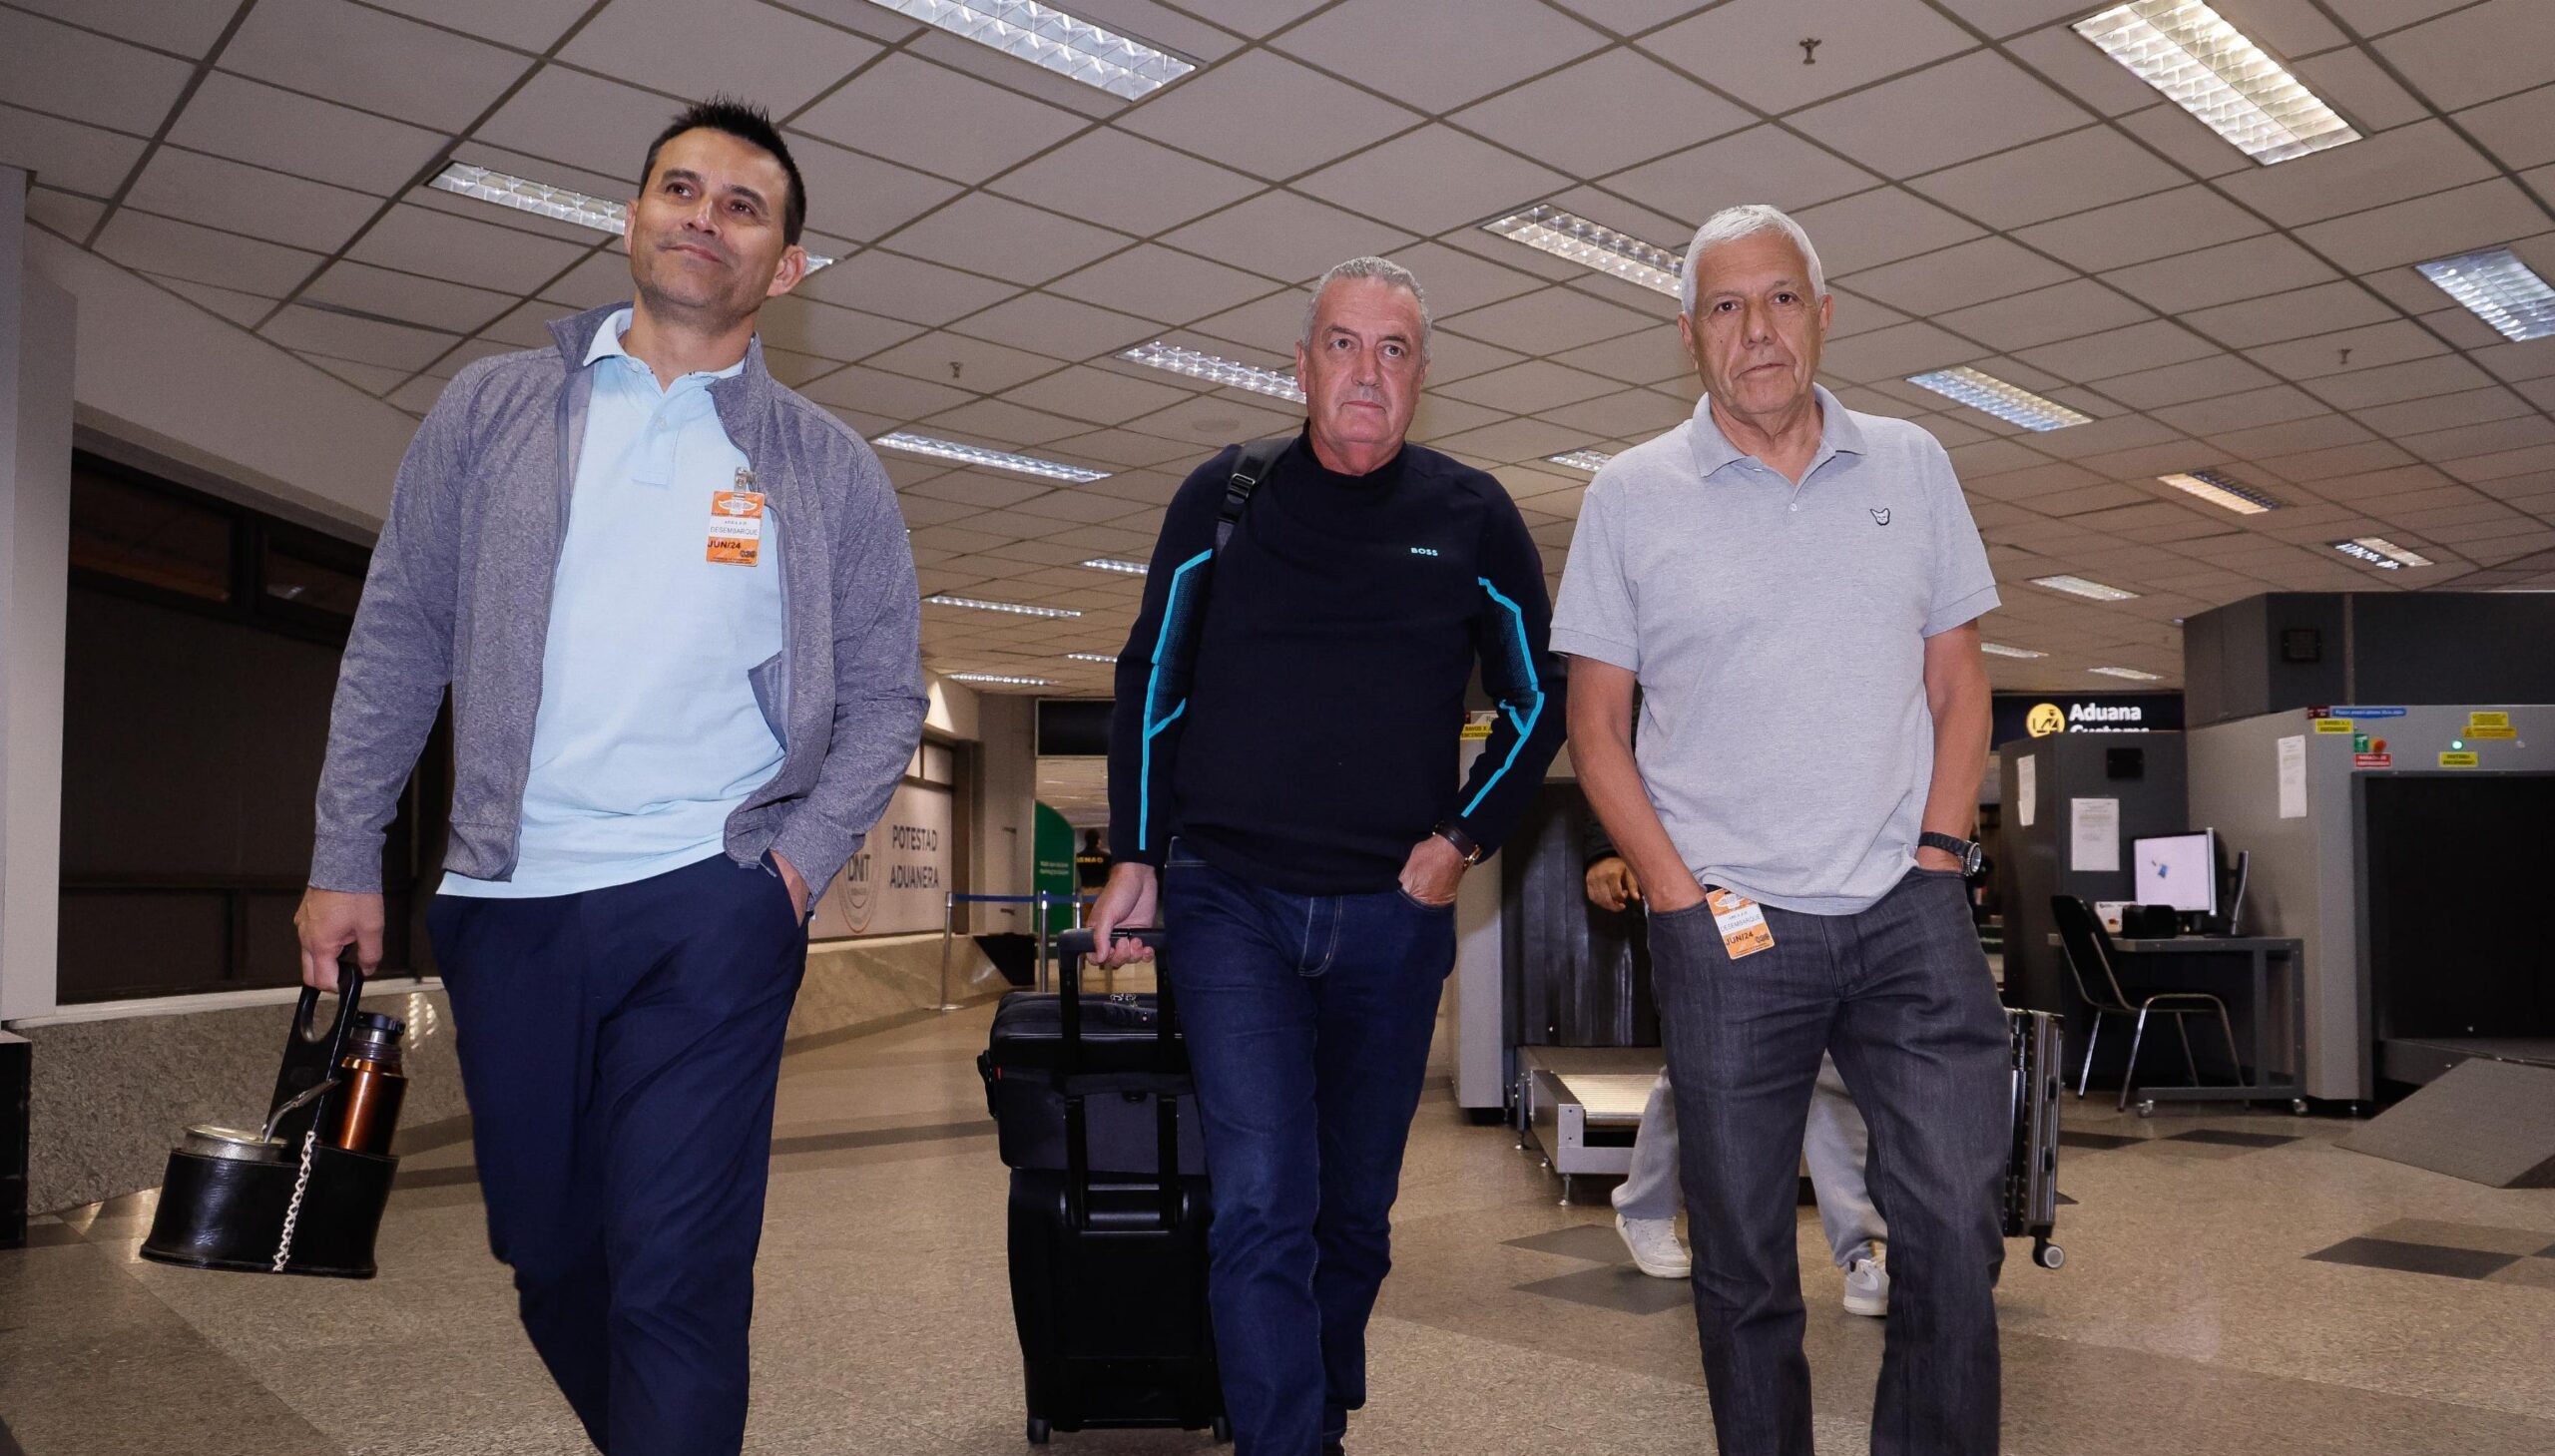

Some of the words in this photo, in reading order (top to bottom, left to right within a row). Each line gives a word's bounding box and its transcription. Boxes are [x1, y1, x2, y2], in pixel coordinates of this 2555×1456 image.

[708, 540, 742, 549] JUN/24
[1410, 547, 1438, 556] BOSS
[2069, 702, 2142, 721] Aduana
[892, 824, 937, 851] POTESTAD
[889, 864, 940, 889] ADUANERA
[1726, 930, 1754, 945] JUN/24
